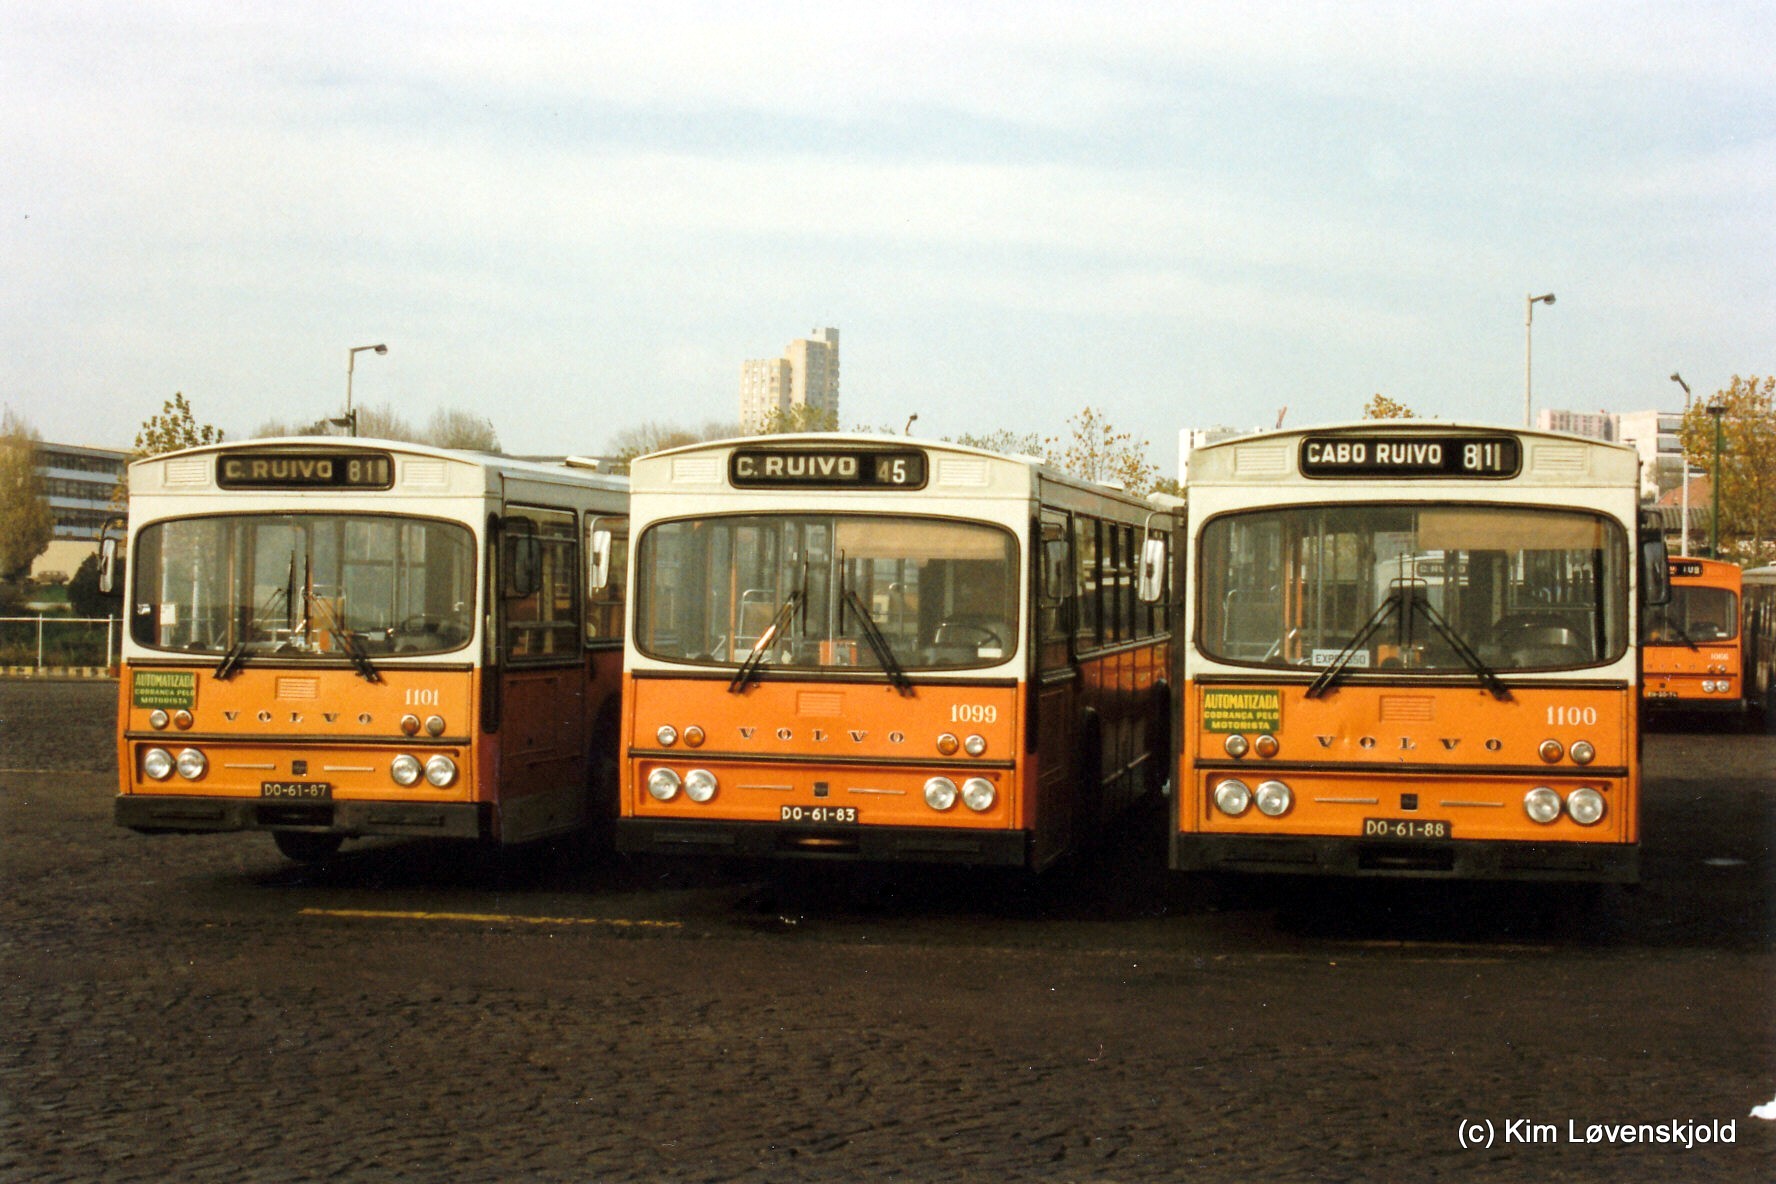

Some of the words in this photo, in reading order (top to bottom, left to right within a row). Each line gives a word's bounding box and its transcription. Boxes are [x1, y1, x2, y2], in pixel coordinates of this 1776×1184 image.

[1307, 443, 1366, 463] CABO
[1376, 443, 1442, 464] RUIVO
[225, 460, 246, 479] C.
[251, 459, 333, 479] RUIVO
[736, 456, 759, 476] C.
[765, 456, 857, 476] RUIVO
[878, 459, 906, 483] 45
[135, 673, 195, 688] AUTOMATIZADA
[176, 688, 195, 697] PELO
[405, 688, 439, 706] 1101
[1204, 694, 1279, 709] AUTOMATIZADA
[224, 710, 373, 725] VOLVO
[950, 704, 997, 723] 1099
[1204, 711, 1254, 720] COBRANÇA
[1256, 711, 1279, 720] PELO
[1546, 706, 1597, 725] 1100
[1211, 721, 1271, 730] MOTORISTA
[738, 727, 905, 744] VOLVO
[1315, 736, 1502, 752] VOLVO
[264, 783, 327, 797] DO-61-87
[782, 806, 856, 822] DO-61-83
[1366, 820, 1445, 837] DO-61-88
